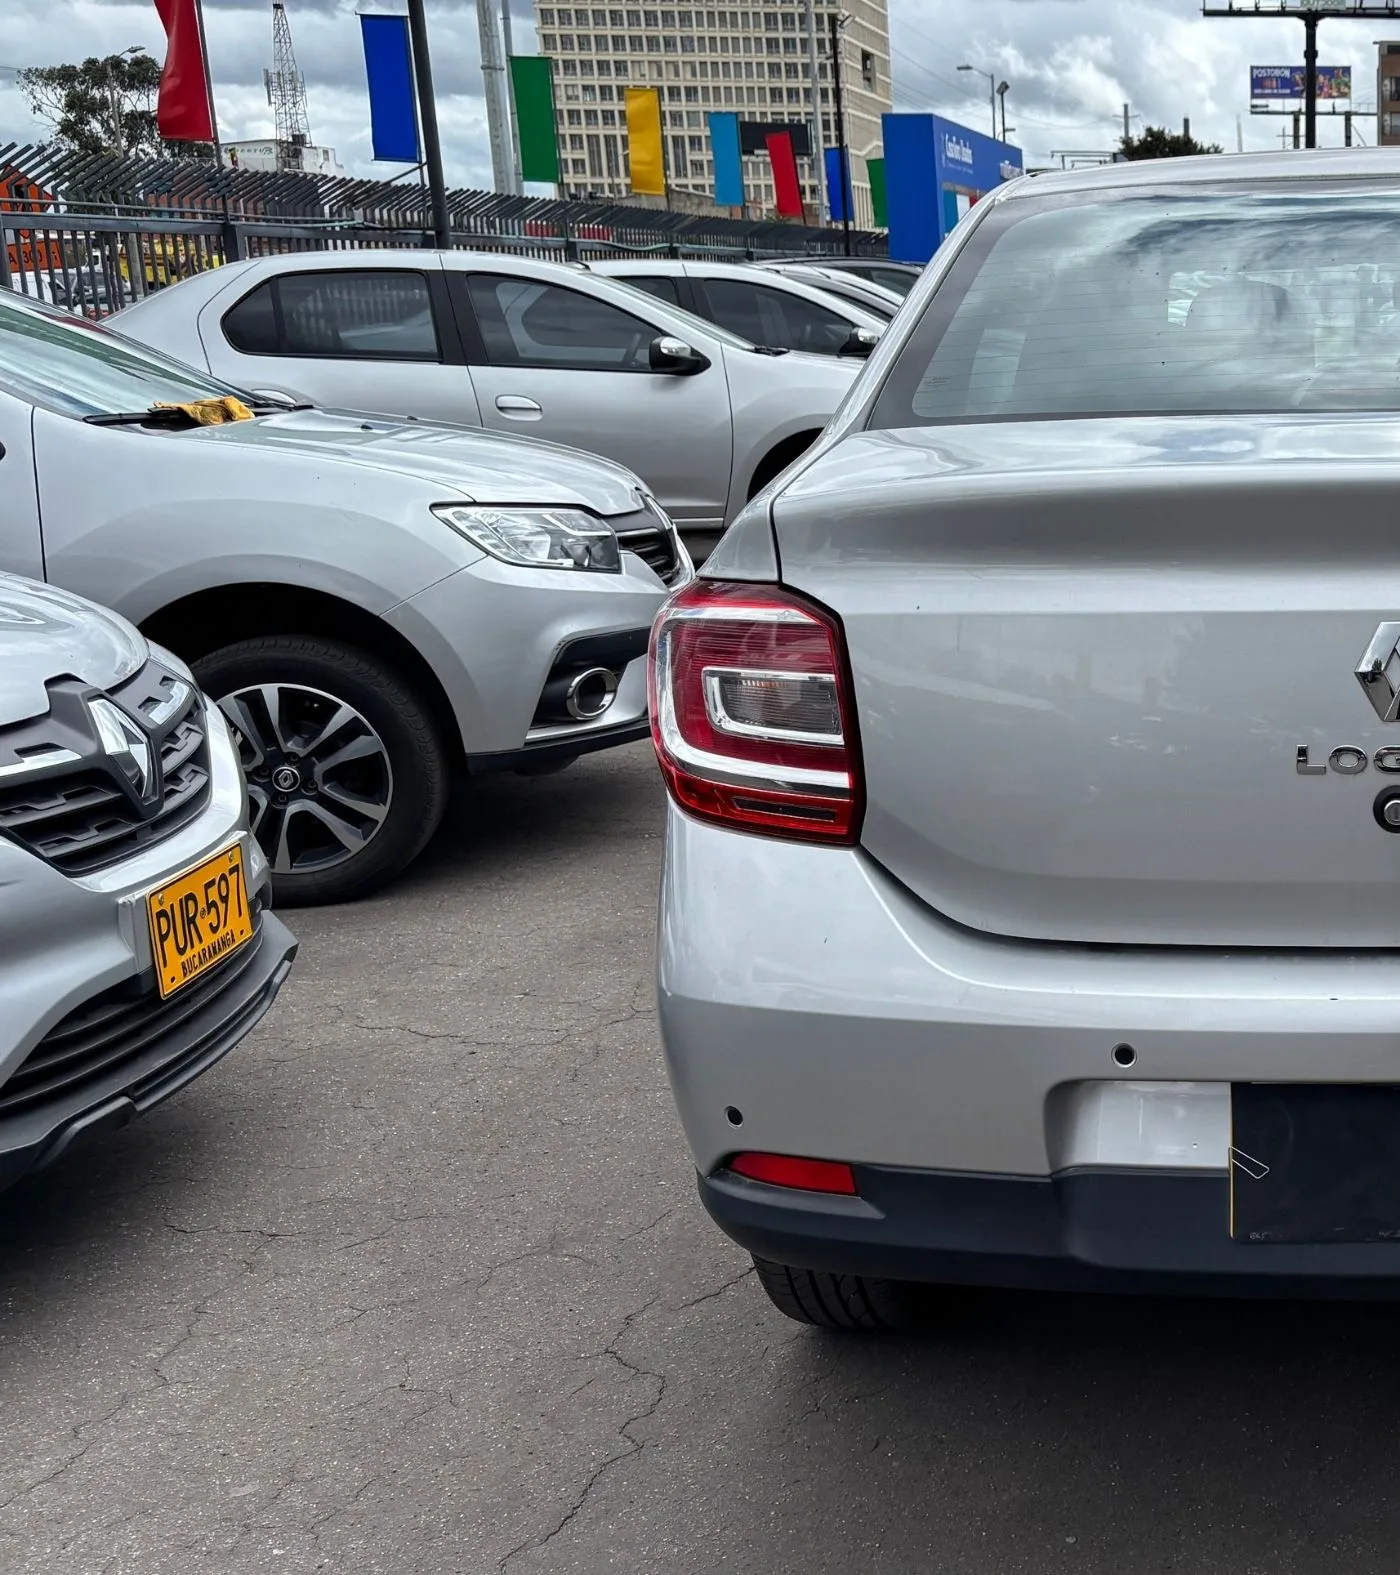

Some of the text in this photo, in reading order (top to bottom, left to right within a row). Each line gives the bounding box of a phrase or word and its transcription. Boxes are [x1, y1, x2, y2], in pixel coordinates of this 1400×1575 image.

[155, 863, 243, 969] PUR 597
[181, 929, 236, 978] BUCARAMANGA
